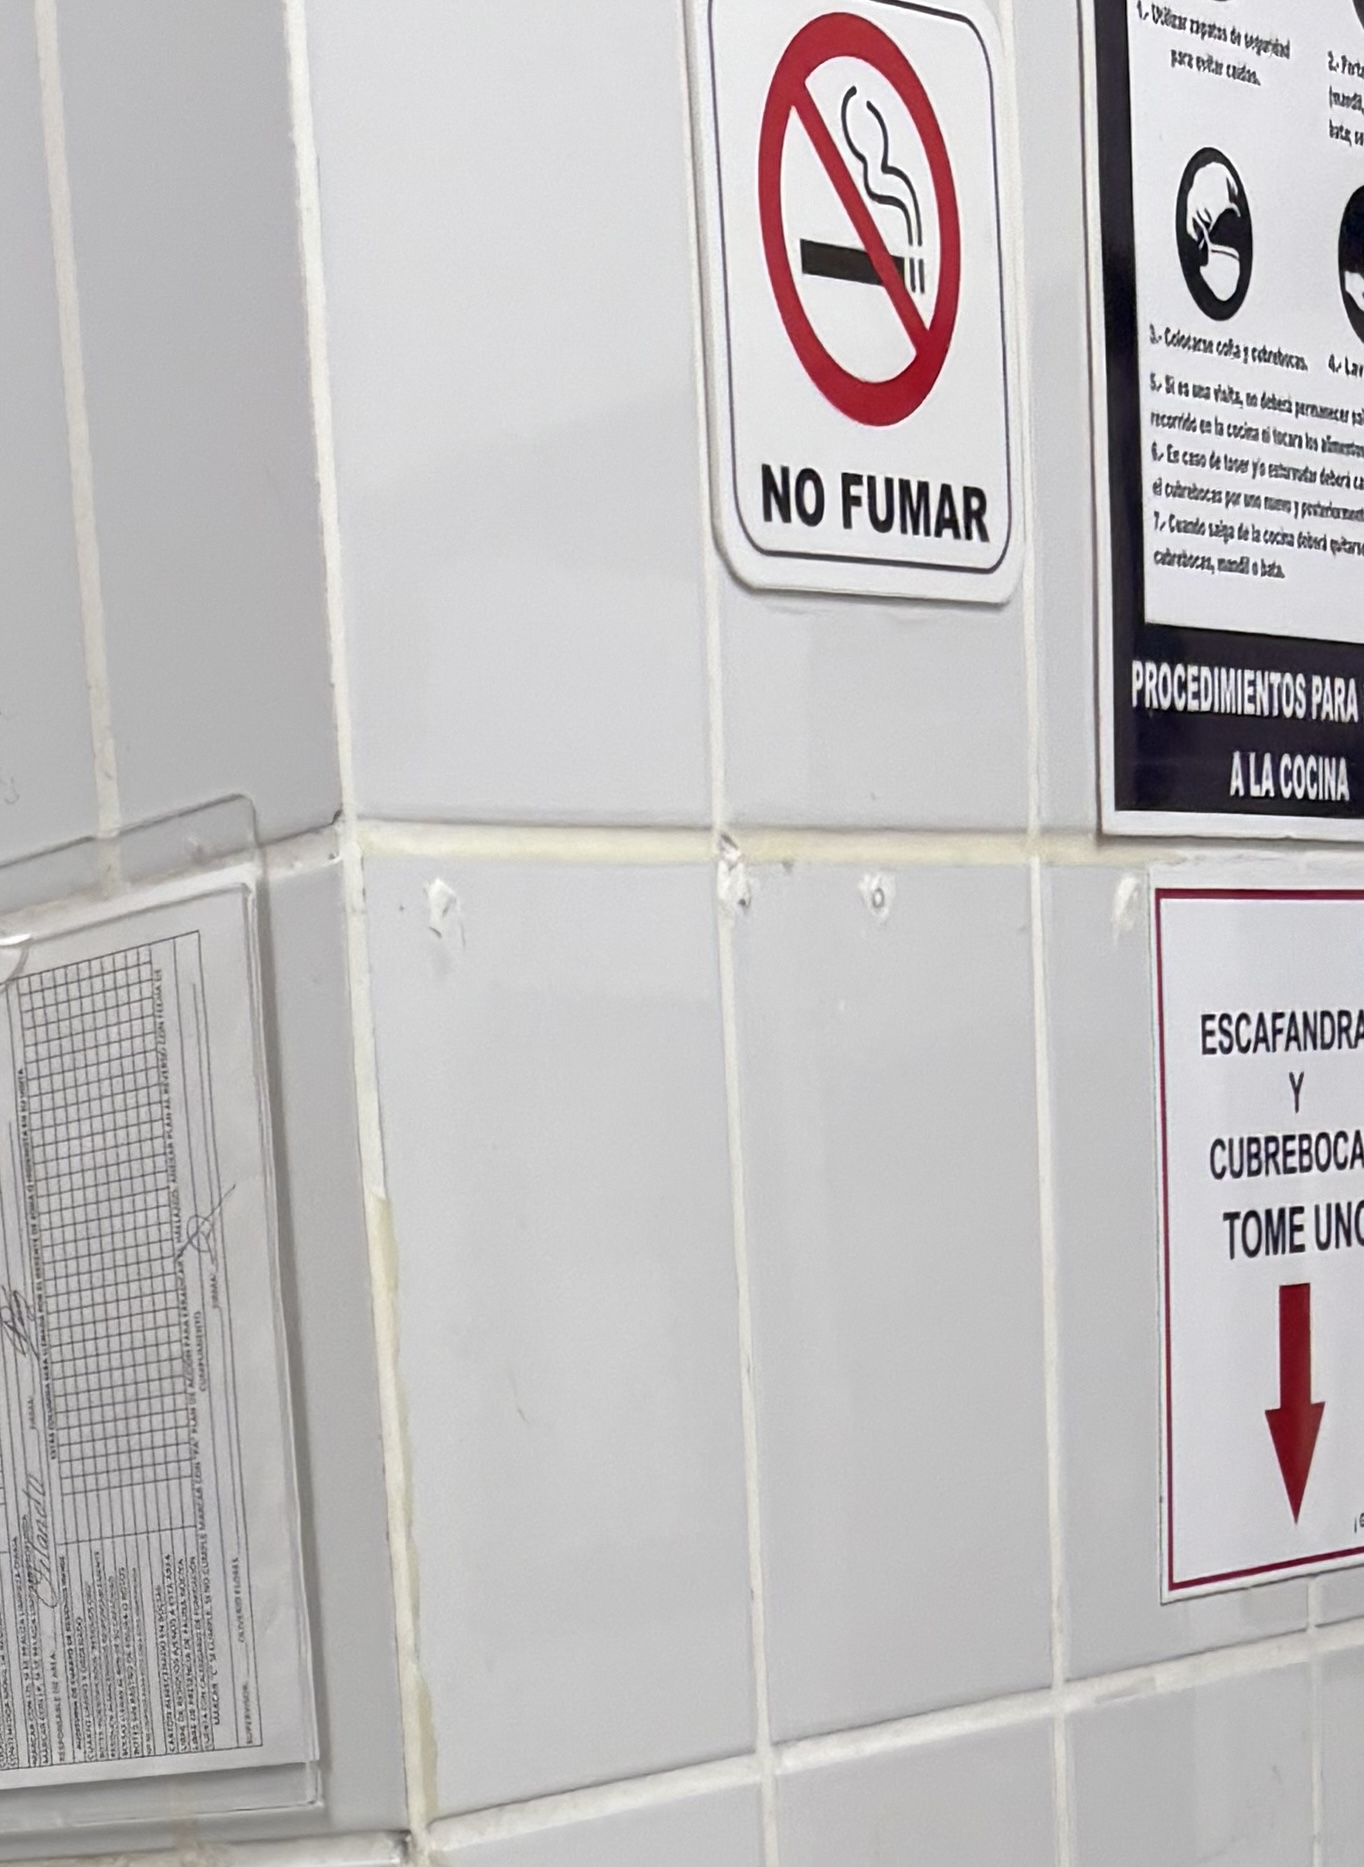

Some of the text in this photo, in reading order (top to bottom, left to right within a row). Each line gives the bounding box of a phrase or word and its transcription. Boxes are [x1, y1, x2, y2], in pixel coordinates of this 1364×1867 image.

[1229, 26, 1242, 47] de
[1170, 48, 1194, 69] para
[1195, 54, 1224, 76] evitar
[1215, 337, 1241, 359] cofia
[1242, 345, 1249, 365] y
[1177, 380, 1190, 398] es
[1191, 383, 1211, 400] una
[1245, 391, 1258, 407] no
[1150, 411, 1198, 433] recorrido
[1198, 418, 1212, 435] en
[1213, 416, 1224, 437] la
[1226, 421, 1260, 442] cocina
[1304, 431, 1319, 452] los
[1181, 450, 1207, 468] caso
[1208, 450, 1222, 471] de
[762, 464, 989, 542] NO FUMAR
[1151, 476, 1163, 496] el
[1164, 479, 1223, 504] cubrebocas
[1224, 490, 1242, 509] por
[1293, 500, 1300, 519] y
[1167, 513, 1206, 536] Cuando
[1236, 522, 1250, 541] de
[1251, 523, 1261, 543] la
[1262, 528, 1295, 548] cocina
[1251, 561, 1259, 576] o
[1132, 661, 1358, 722] PROCEDIMIENTOS PARA
[1230, 751, 1349, 800] A LA COCINA
[1289, 1072, 1304, 1113] Y
[1223, 1206, 1305, 1259] TOME
